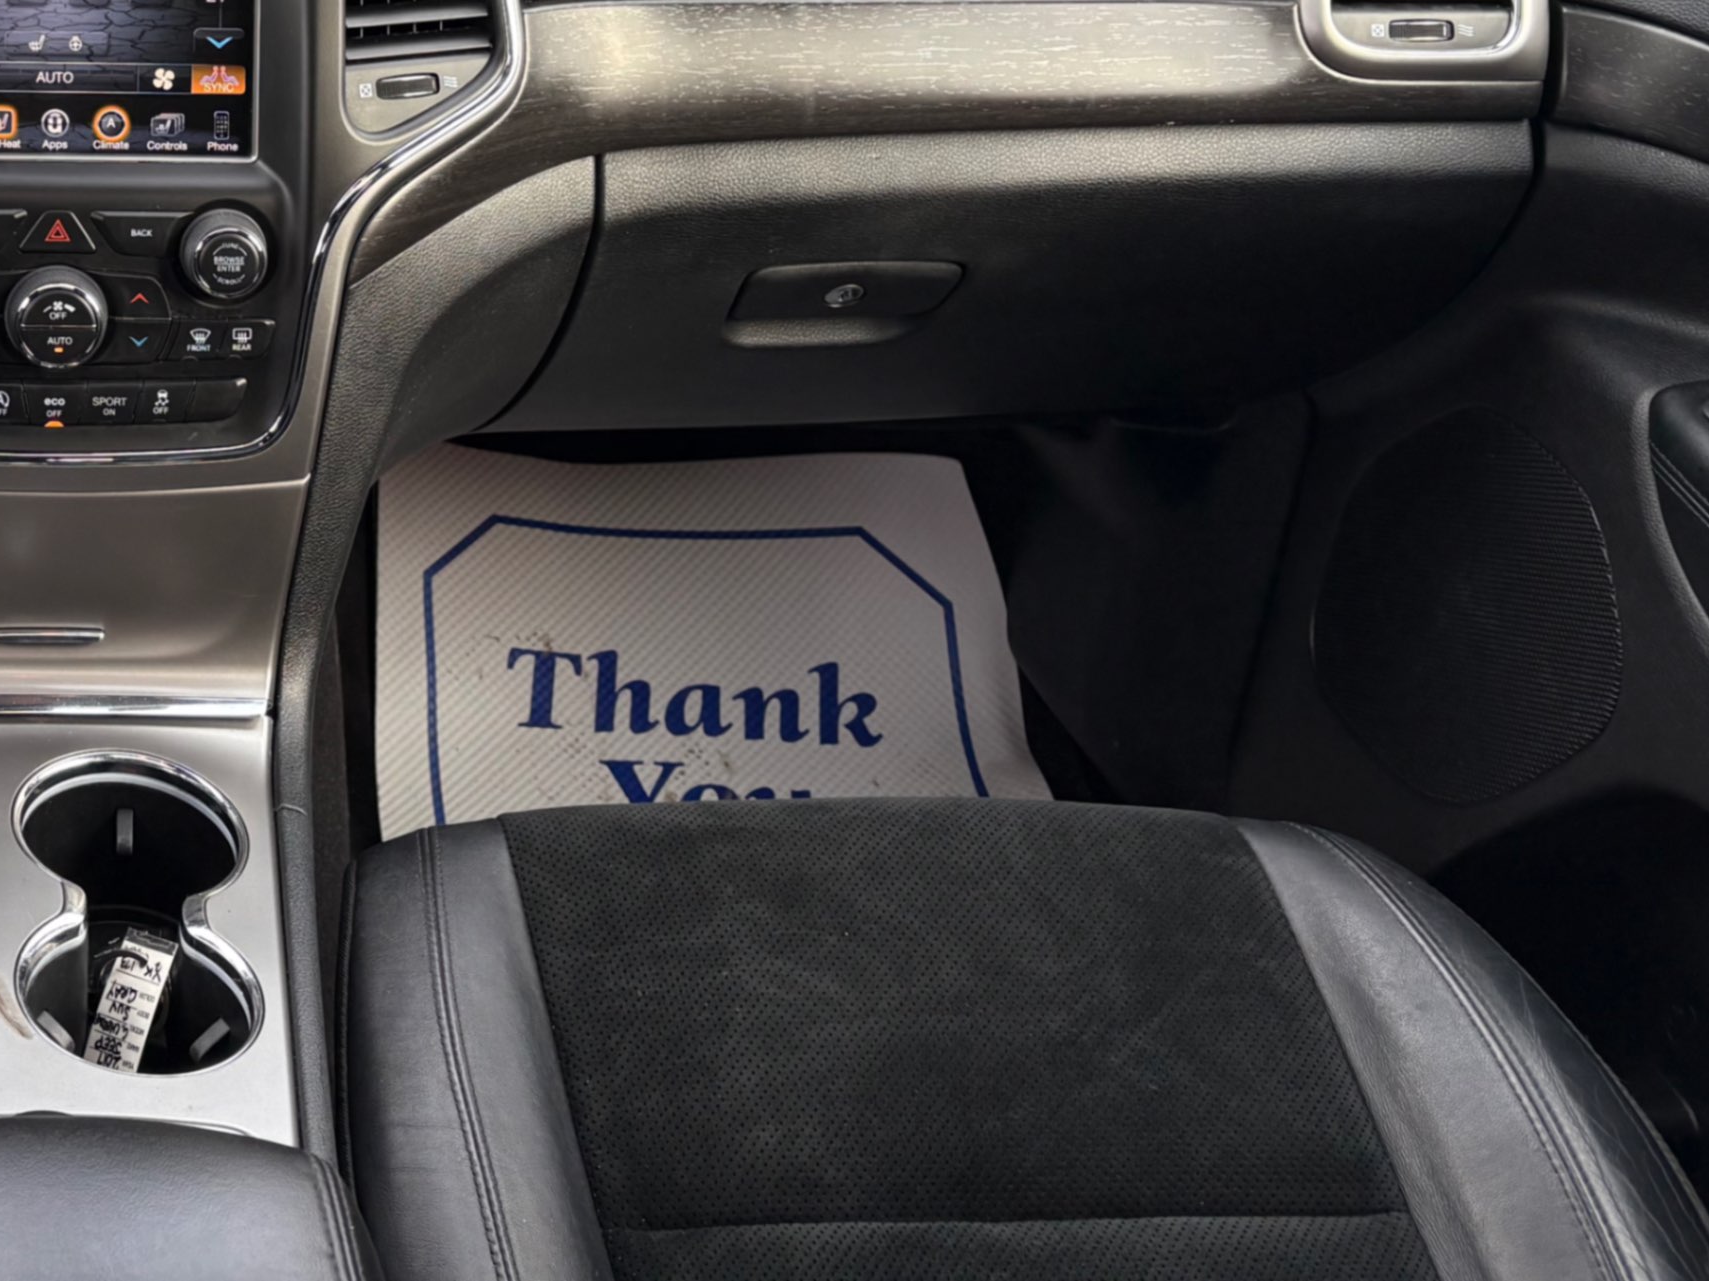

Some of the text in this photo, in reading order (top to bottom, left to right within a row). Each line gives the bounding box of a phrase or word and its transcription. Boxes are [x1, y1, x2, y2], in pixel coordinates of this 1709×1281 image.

[36, 71, 74, 84] AUTO
[203, 82, 234, 94] SYNC
[42, 139, 68, 151] Apps
[93, 138, 130, 150] Climate
[147, 139, 188, 151] Controls
[207, 140, 239, 152] Phone
[130, 228, 153, 238] BACK
[213, 255, 245, 265] BROWSE
[49, 311, 67, 321] OFF
[47, 336, 73, 347] AUTO
[186, 343, 211, 353] FRONT
[232, 343, 252, 352] REAR
[44, 396, 66, 408] eco
[93, 396, 127, 408] SPORT
[45, 409, 62, 418] OFF
[102, 409, 116, 417] ON
[152, 406, 169, 415] OFF
[505, 646, 884, 749] Thank
